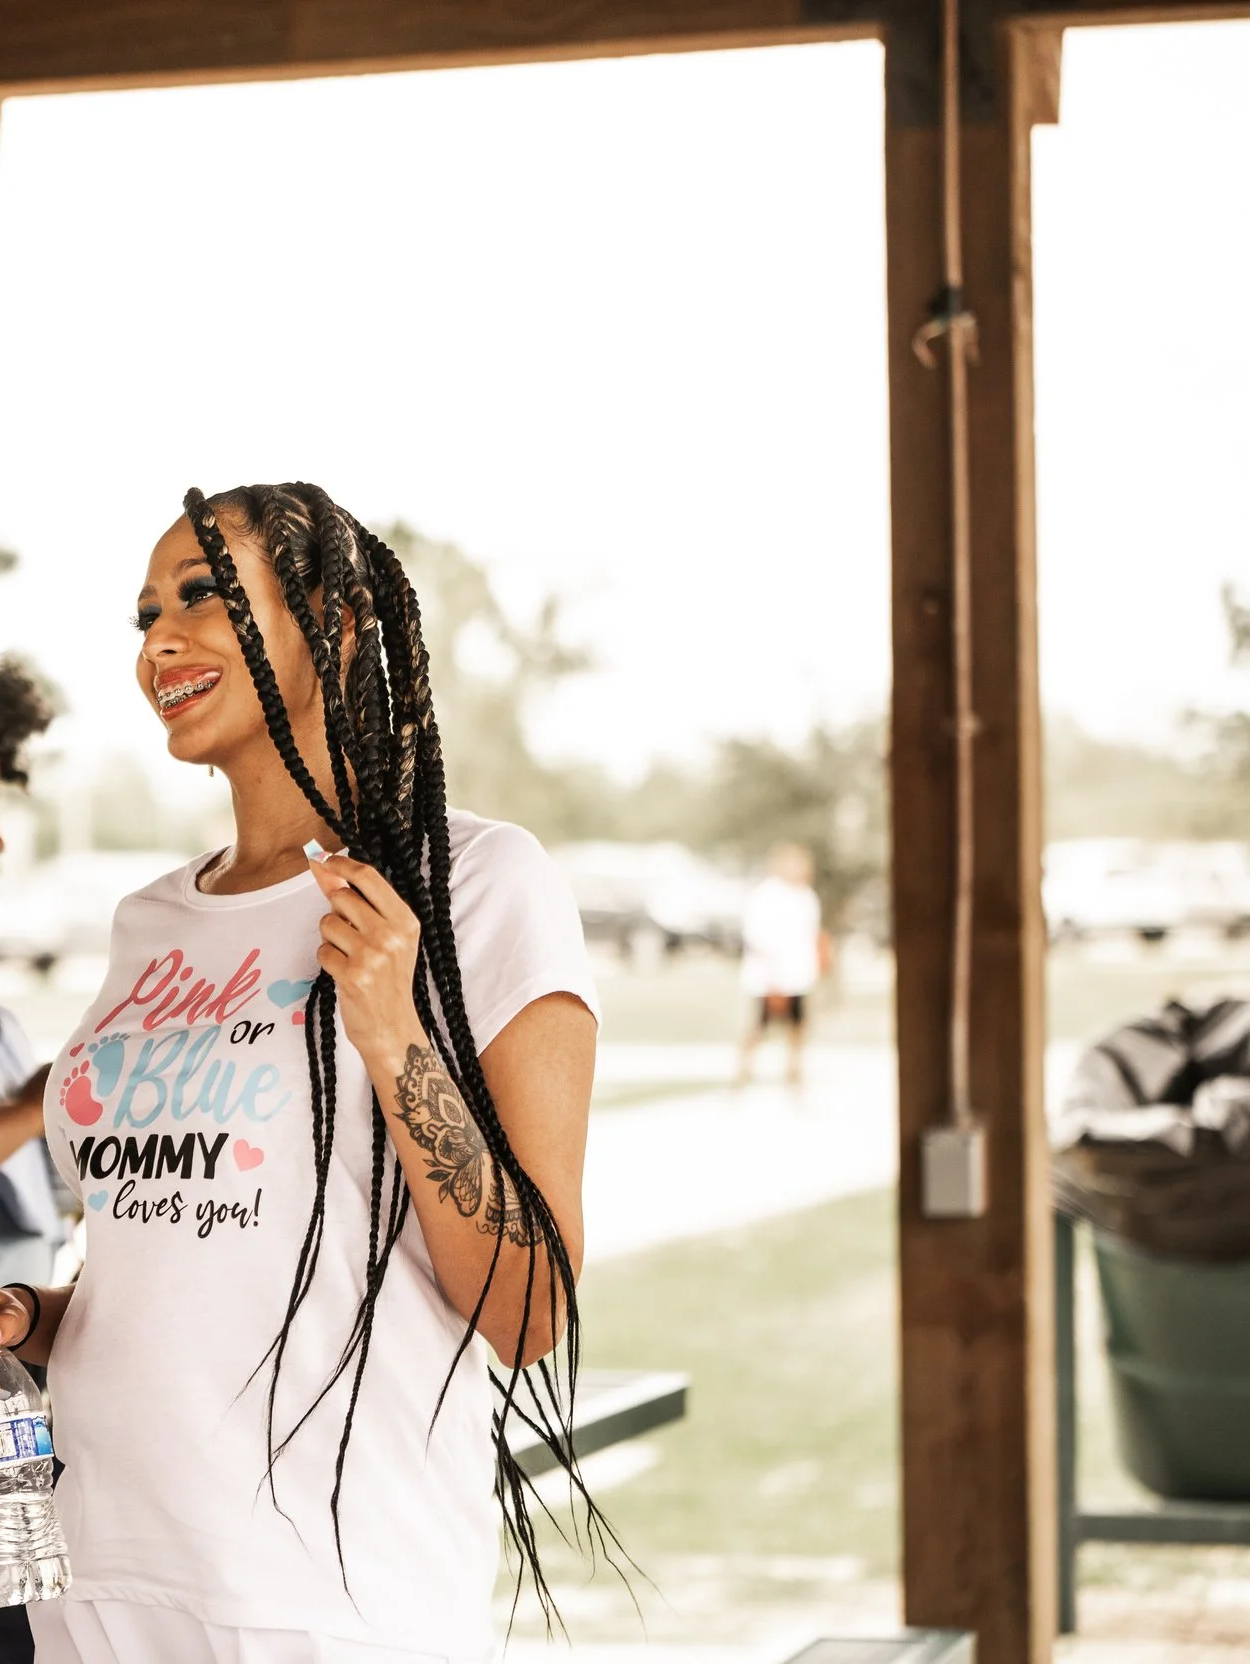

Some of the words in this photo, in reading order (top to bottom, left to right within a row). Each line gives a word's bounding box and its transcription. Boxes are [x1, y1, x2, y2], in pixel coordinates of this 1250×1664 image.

[95, 949, 261, 1033] Pink
[230, 1020, 275, 1044] or
[113, 1024, 292, 1129] Blue
[112, 1179, 188, 1224] loves
[196, 1188, 263, 1239] you!
